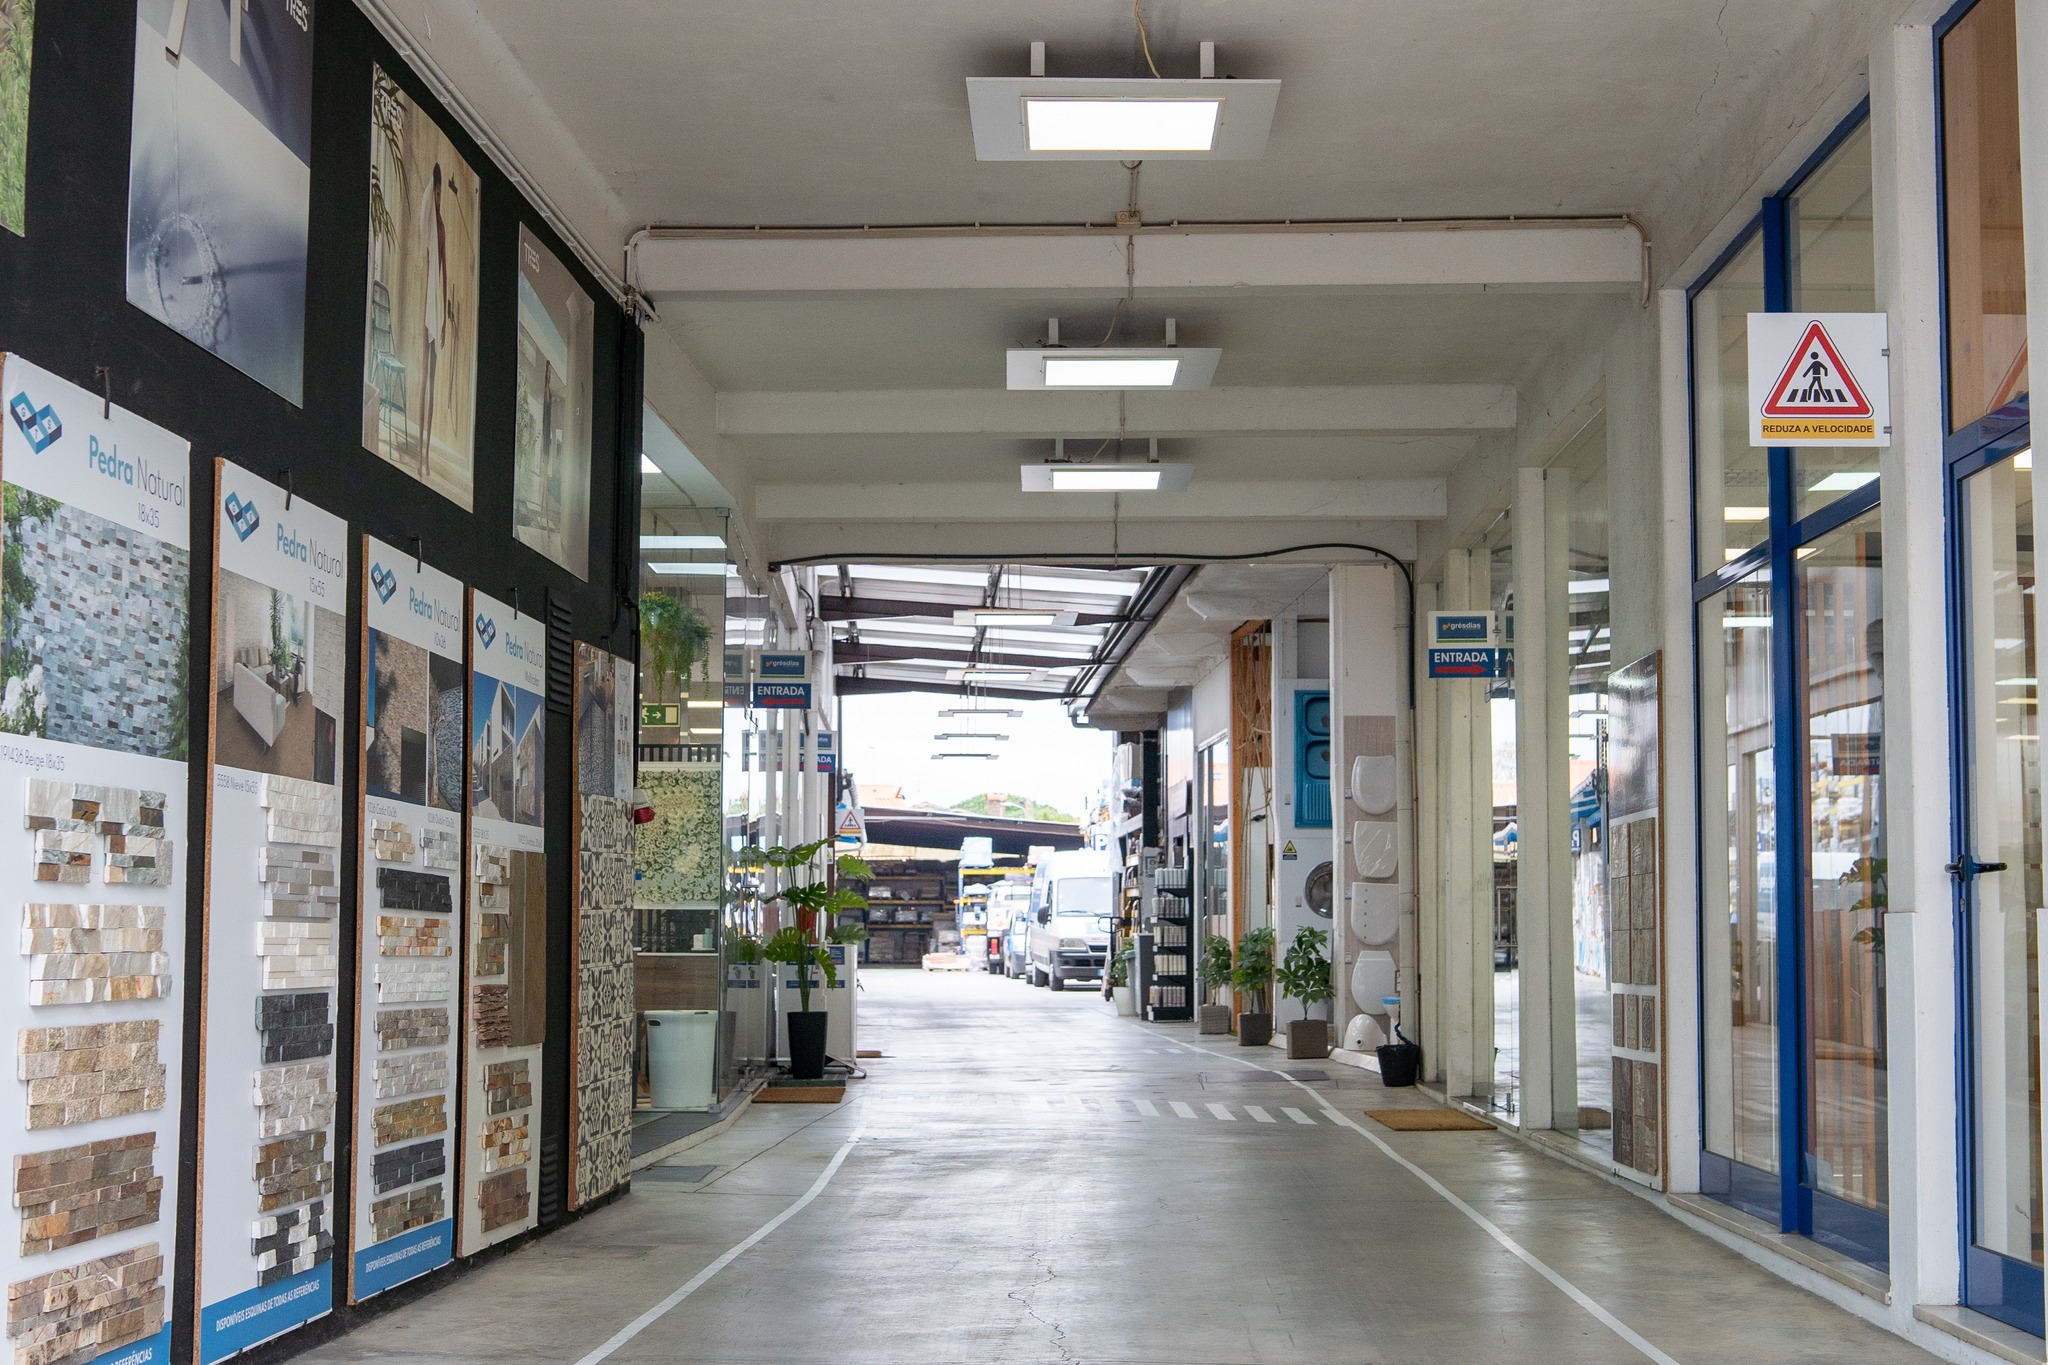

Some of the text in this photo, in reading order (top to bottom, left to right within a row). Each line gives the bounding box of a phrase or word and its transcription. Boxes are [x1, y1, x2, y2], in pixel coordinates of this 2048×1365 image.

[524, 241, 540, 273] TRES
[1762, 424, 1873, 433] REDUZA A VELOCIDADE
[89, 434, 186, 508] Pedra Natural
[137, 502, 160, 528] 18x35
[276, 522, 344, 579] Pedra Natural
[409, 586, 433, 620] Pedra
[434, 598, 461, 632] Natural
[1449, 622, 1481, 630] grésdias
[505, 631, 524, 660] Pedra
[1434, 651, 1489, 663] ENTRADA
[757, 685, 805, 696] ENTRADA
[25, 749, 45, 772] Beige
[46, 753, 65, 772] 18x35
[215, 1279, 320, 1333] DISPONÍVEIS ESQUINAS DE TODAS AS REFERÊNCIAS
